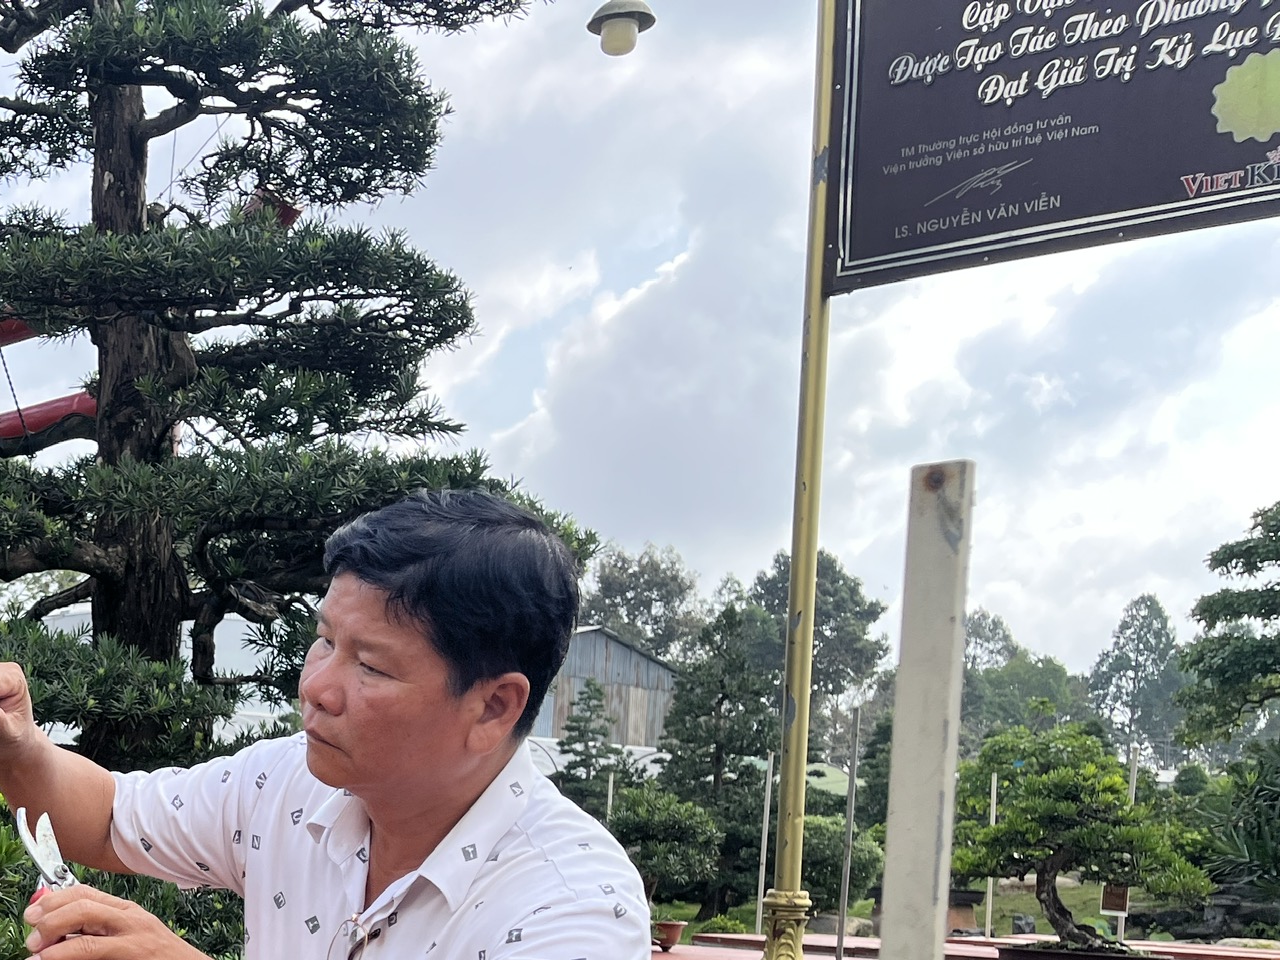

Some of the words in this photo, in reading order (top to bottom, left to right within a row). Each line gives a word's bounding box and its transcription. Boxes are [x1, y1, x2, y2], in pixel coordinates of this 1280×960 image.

[961, 0, 1012, 33] Cặp
[888, 53, 951, 85] Được
[955, 38, 1004, 72] Tạo
[1009, 25, 1058, 57] Tác
[1063, 11, 1130, 45] Theo
[977, 70, 1030, 106] Đạt
[1034, 56, 1089, 99] Giá
[1093, 46, 1138, 81] Trị
[1202, 21, 1258, 57] Lục
[982, 127, 1002, 140] Hội
[1046, 127, 1069, 142] Việt
[1071, 124, 1100, 138] Nam
[916, 207, 982, 236] NGUYỄN
[986, 203, 1020, 221] VĂN
[1024, 191, 1061, 214] VIỄN
